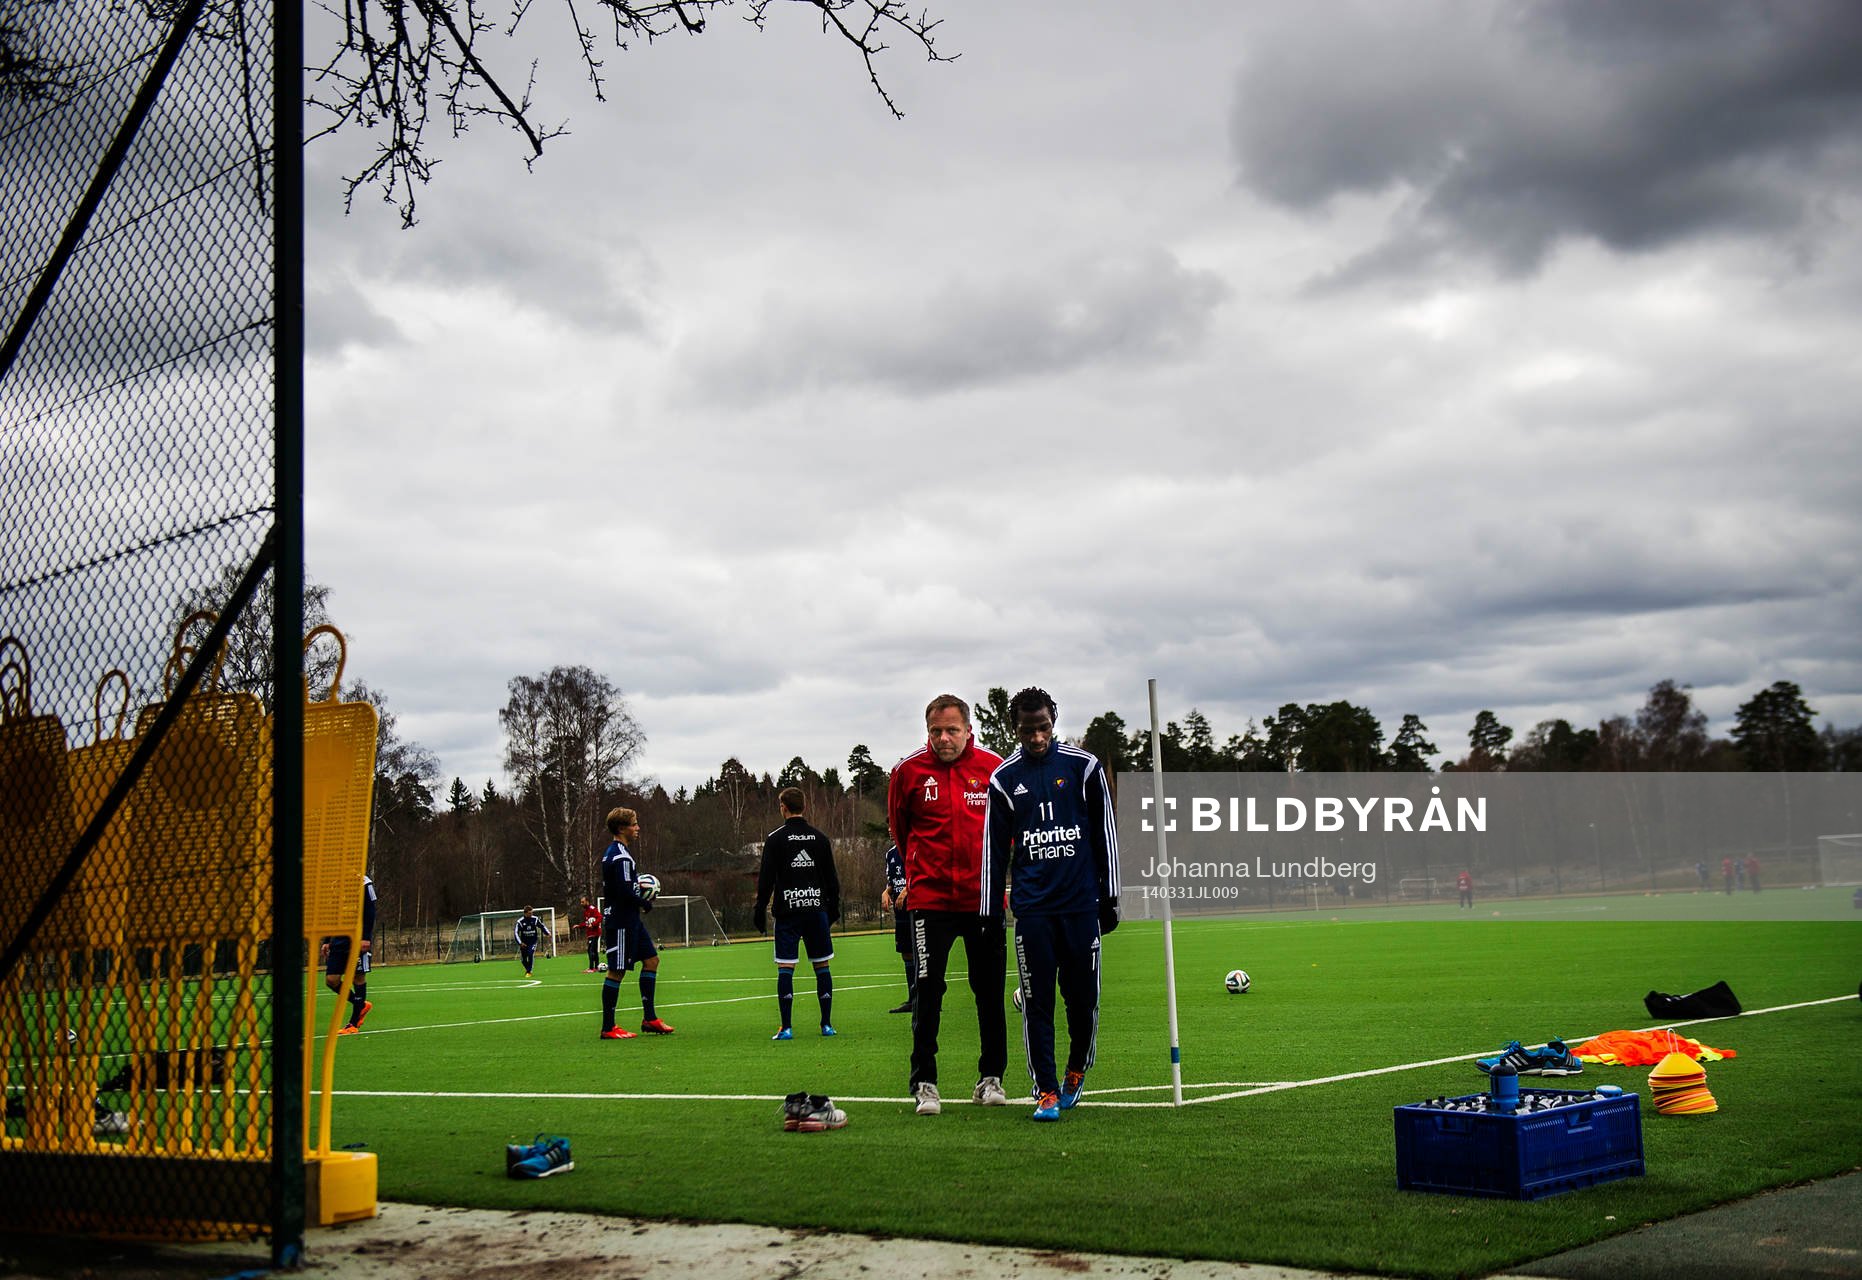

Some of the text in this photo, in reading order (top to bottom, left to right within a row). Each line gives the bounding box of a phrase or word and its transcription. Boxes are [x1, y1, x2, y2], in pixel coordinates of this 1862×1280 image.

[925, 786, 938, 802] AJ
[1039, 801, 1054, 821] 11
[1023, 824, 1081, 846] Prioritet
[1028, 844, 1075, 860] Finans
[783, 886, 821, 901] Priorite
[789, 898, 821, 909] Finans
